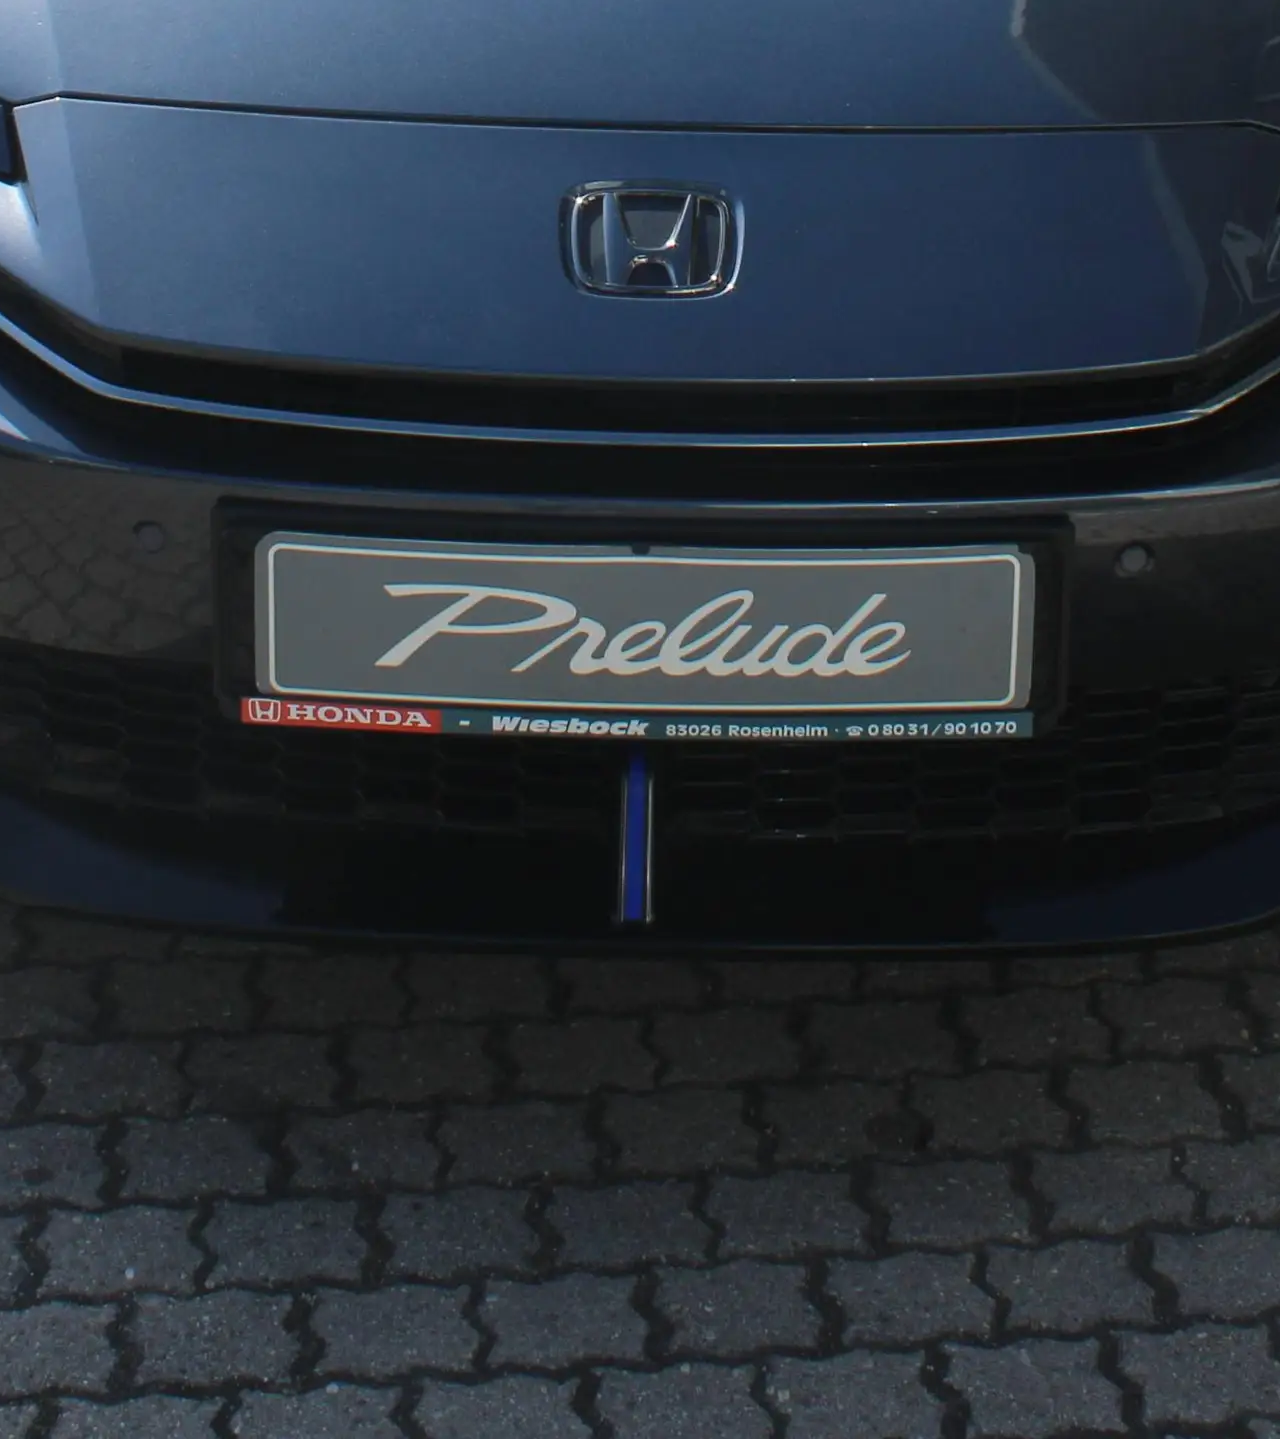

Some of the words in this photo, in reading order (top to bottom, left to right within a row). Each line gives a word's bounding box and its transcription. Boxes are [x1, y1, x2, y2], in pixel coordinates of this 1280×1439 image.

[373, 583, 913, 678] Prelude
[287, 703, 432, 728] HONDA
[666, 724, 722, 737] 83026
[728, 724, 828, 738] Rosenheim
